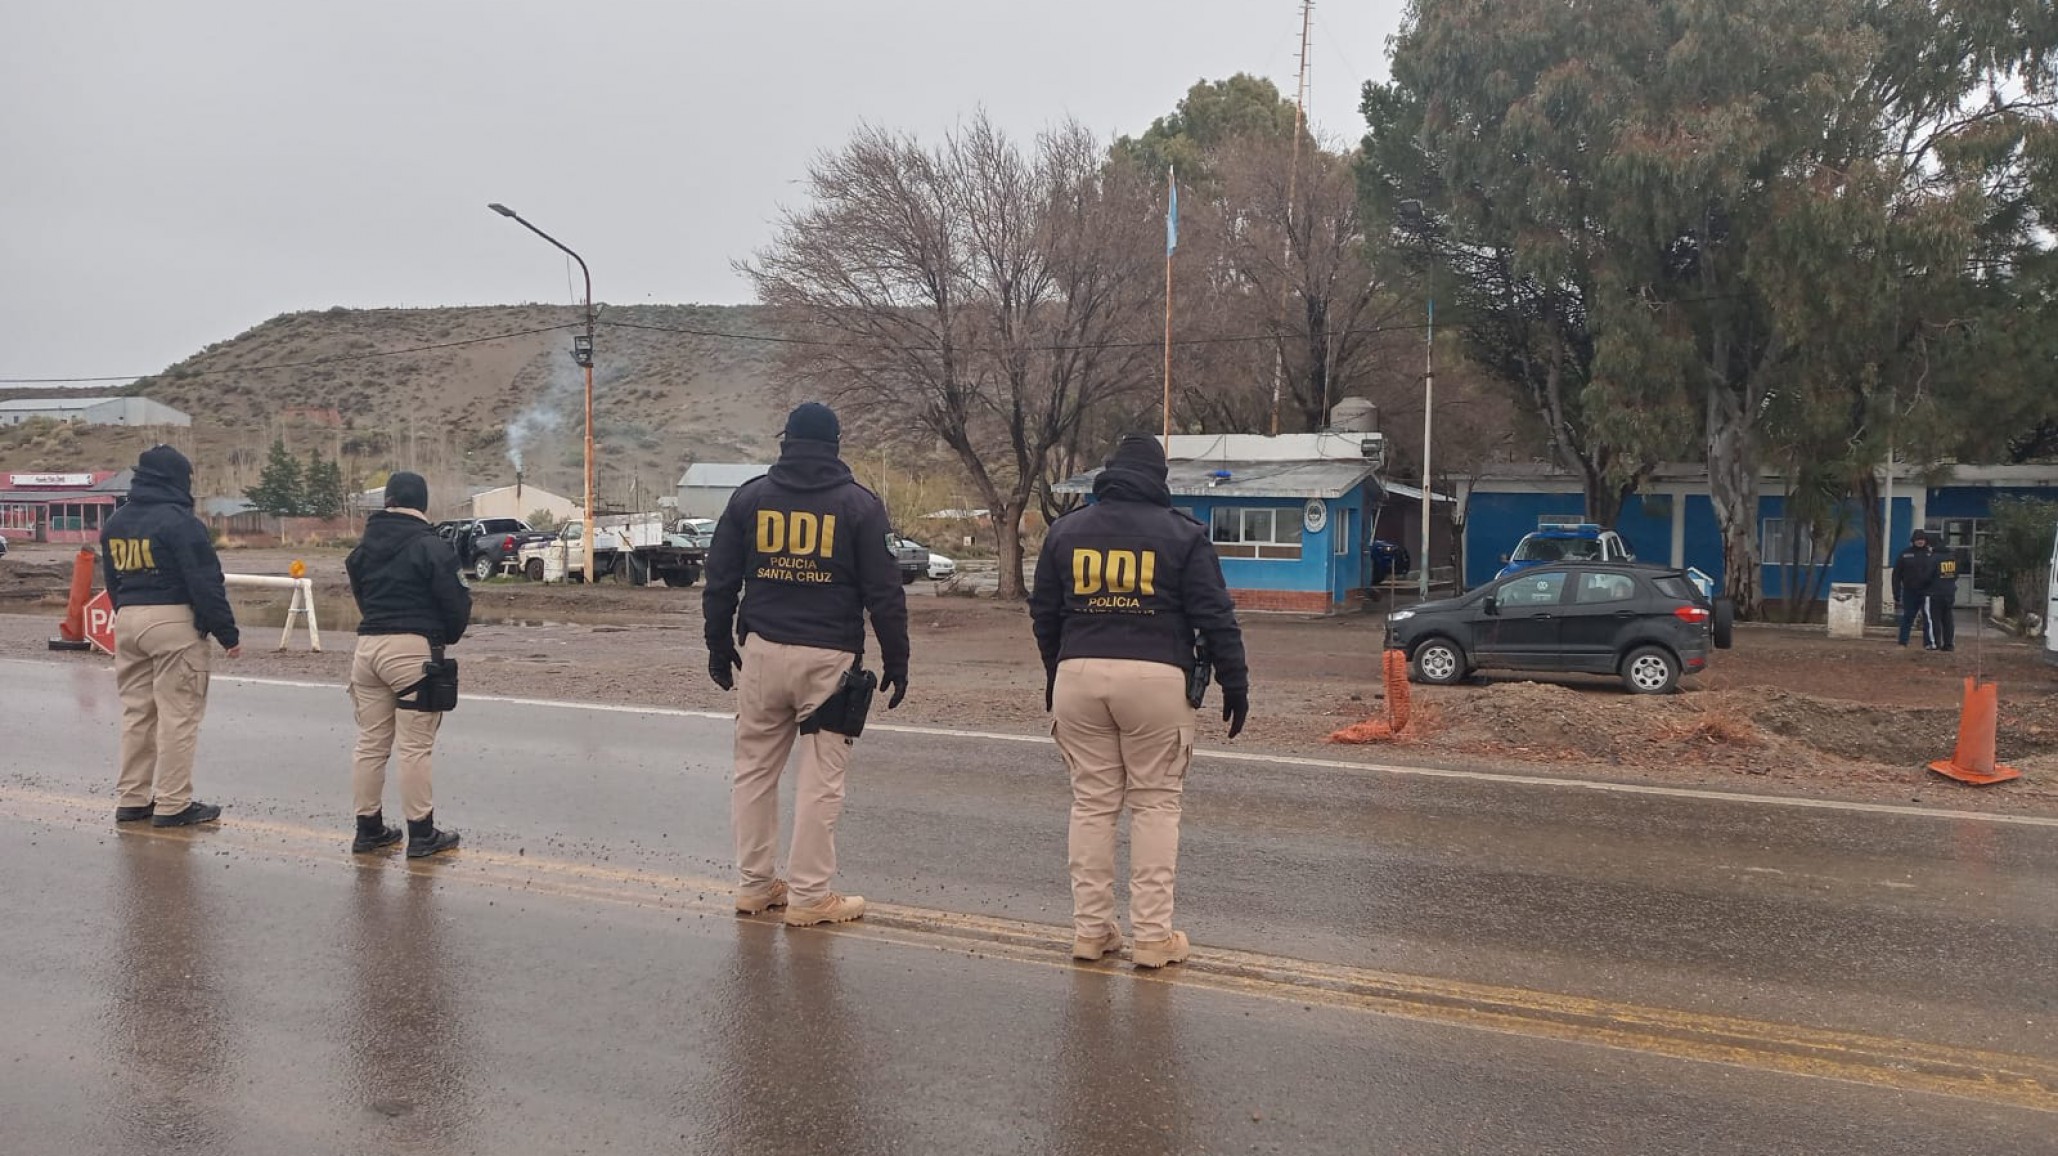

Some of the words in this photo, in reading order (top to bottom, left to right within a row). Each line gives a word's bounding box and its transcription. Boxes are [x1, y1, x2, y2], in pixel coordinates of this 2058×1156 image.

[757, 510, 836, 558] DDI
[109, 538, 156, 571] DDI
[770, 556, 818, 570] POLICIA
[757, 567, 793, 582] SANTA
[796, 571, 832, 583] CRUZ
[1073, 549, 1156, 595] DDI
[1088, 596, 1140, 608] POLICIA
